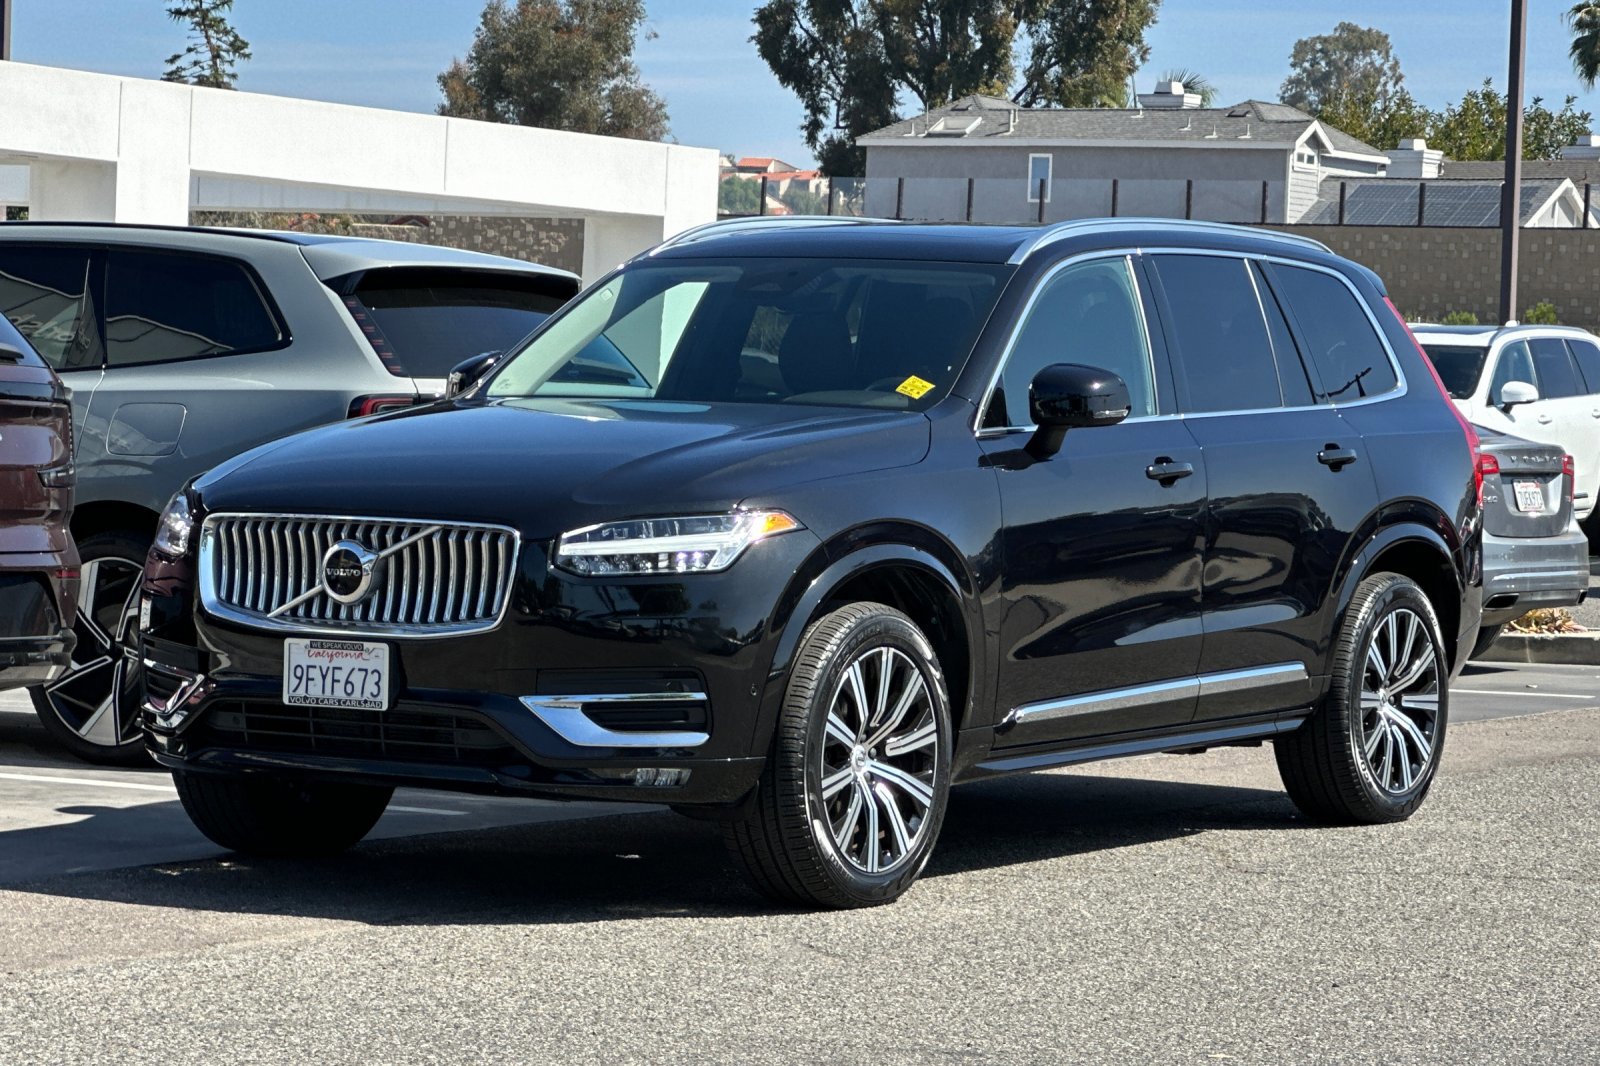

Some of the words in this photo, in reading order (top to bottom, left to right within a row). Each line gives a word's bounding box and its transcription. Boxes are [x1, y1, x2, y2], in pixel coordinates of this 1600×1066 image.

[326, 567, 361, 577] VOLVO
[311, 641, 321, 649] WE
[323, 641, 342, 650] SPEAK
[343, 643, 363, 651] VOLVO
[292, 664, 381, 698] 9FYF673
[289, 695, 316, 704] VOLVO
[318, 697, 338, 706] CARS
[340, 698, 382, 709] CARLSBAD
